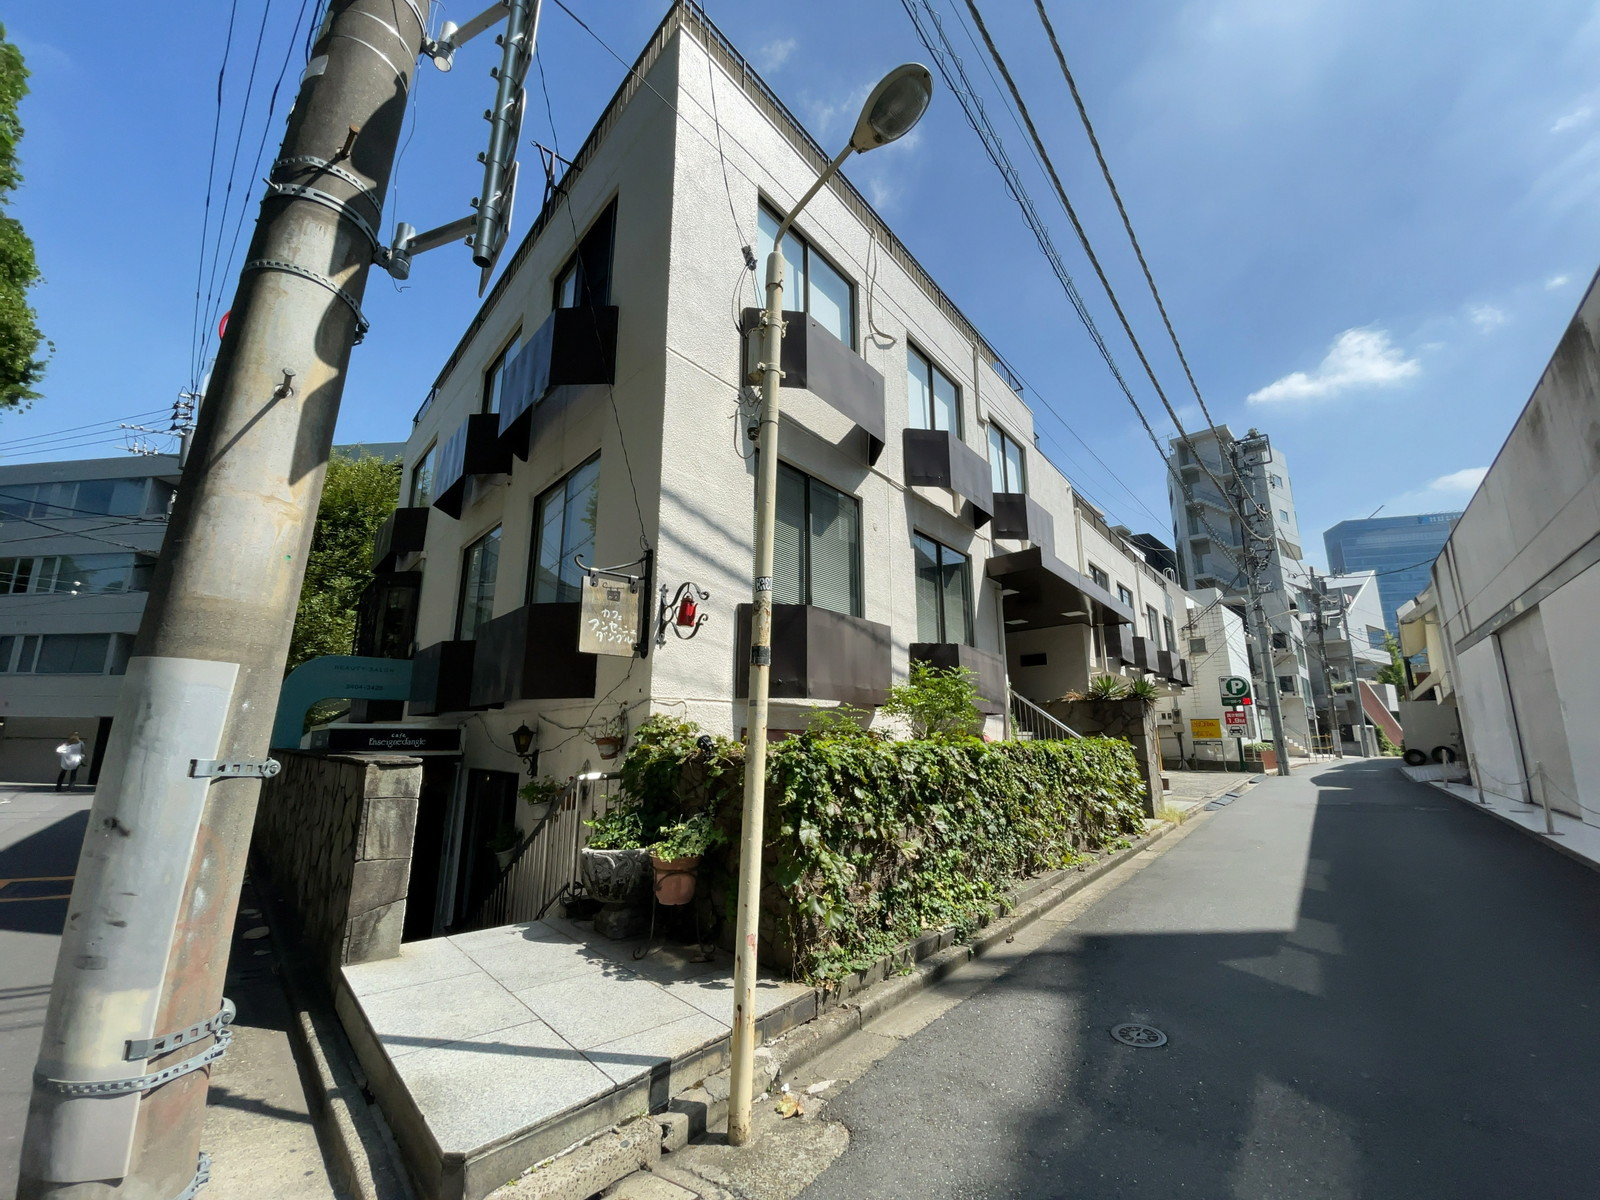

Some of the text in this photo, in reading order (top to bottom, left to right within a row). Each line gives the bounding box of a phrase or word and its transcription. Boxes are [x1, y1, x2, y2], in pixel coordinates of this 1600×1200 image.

[601, 608, 622, 621] カフェ
[1230, 680, 1243, 694] P
